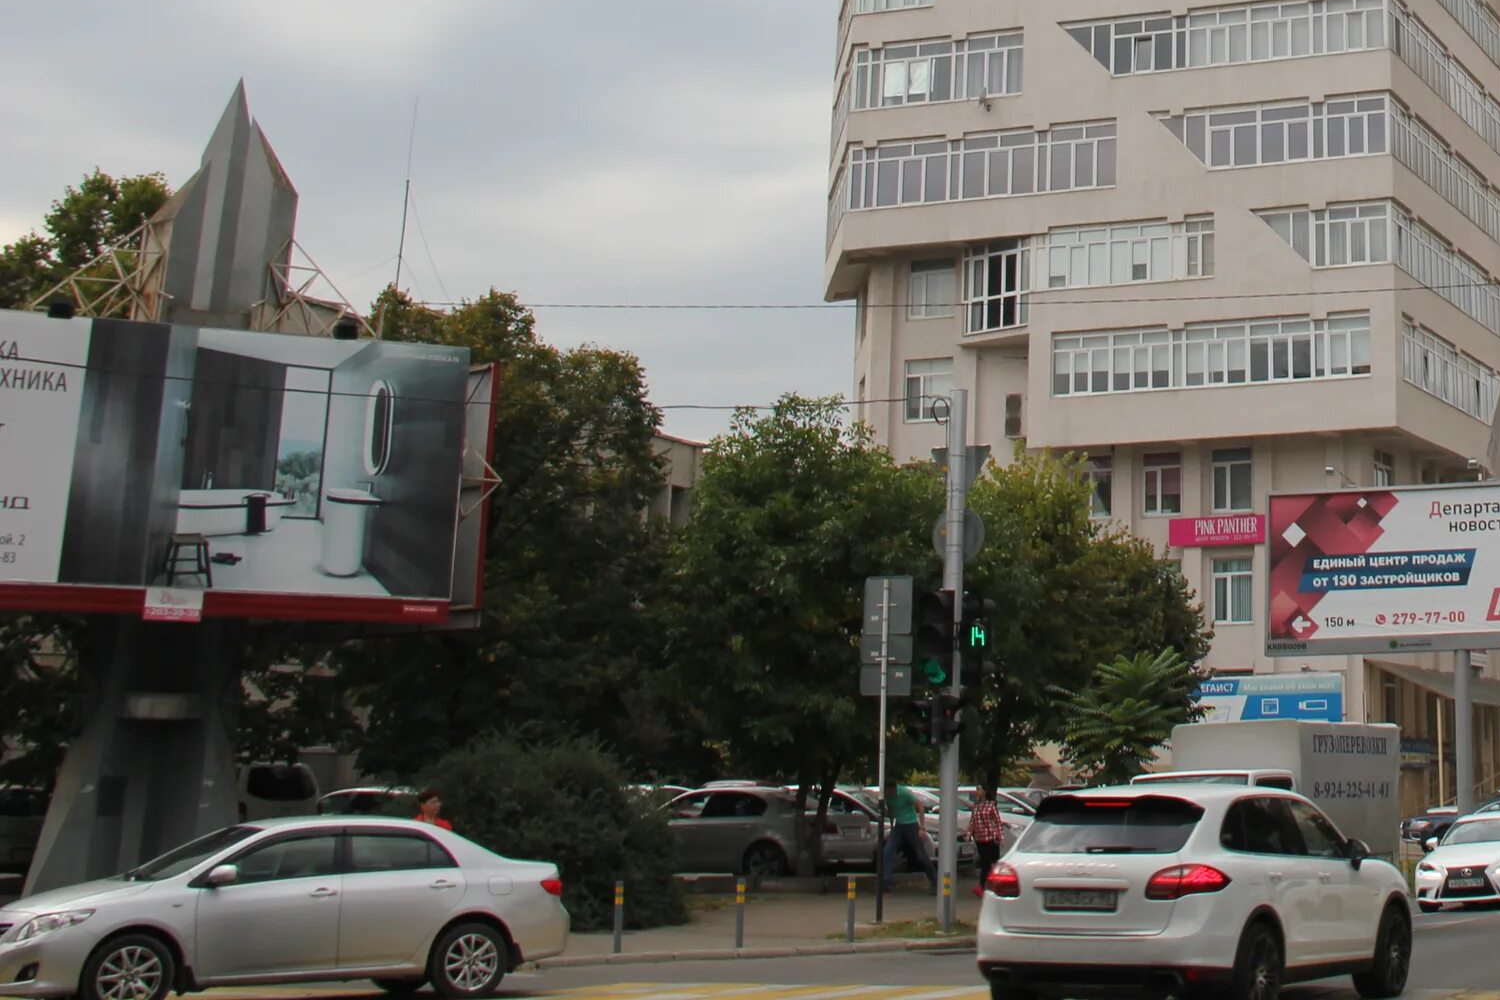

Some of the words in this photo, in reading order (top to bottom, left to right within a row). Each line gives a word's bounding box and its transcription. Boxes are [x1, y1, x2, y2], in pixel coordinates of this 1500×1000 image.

[1195, 520, 1215, 535] PINK
[1217, 517, 1257, 534] PANTHER
[1313, 555, 1366, 570] ЕДИНЫЙ
[1369, 555, 1409, 569] ЦЕНТР
[1412, 553, 1466, 566] ПРОДАЖ
[1332, 575, 1357, 587] 130
[1360, 571, 1460, 586] ЗАСТРОЙЩИКОВ
[1324, 617, 1343, 628] 150
[1392, 611, 1465, 625] 279-77-00
[971, 626, 985, 646] 14
[1201, 682, 1233, 693] ЕГАИС?
[1313, 735, 1387, 755] ГРУЗОПЕРЕВОЗКИ
